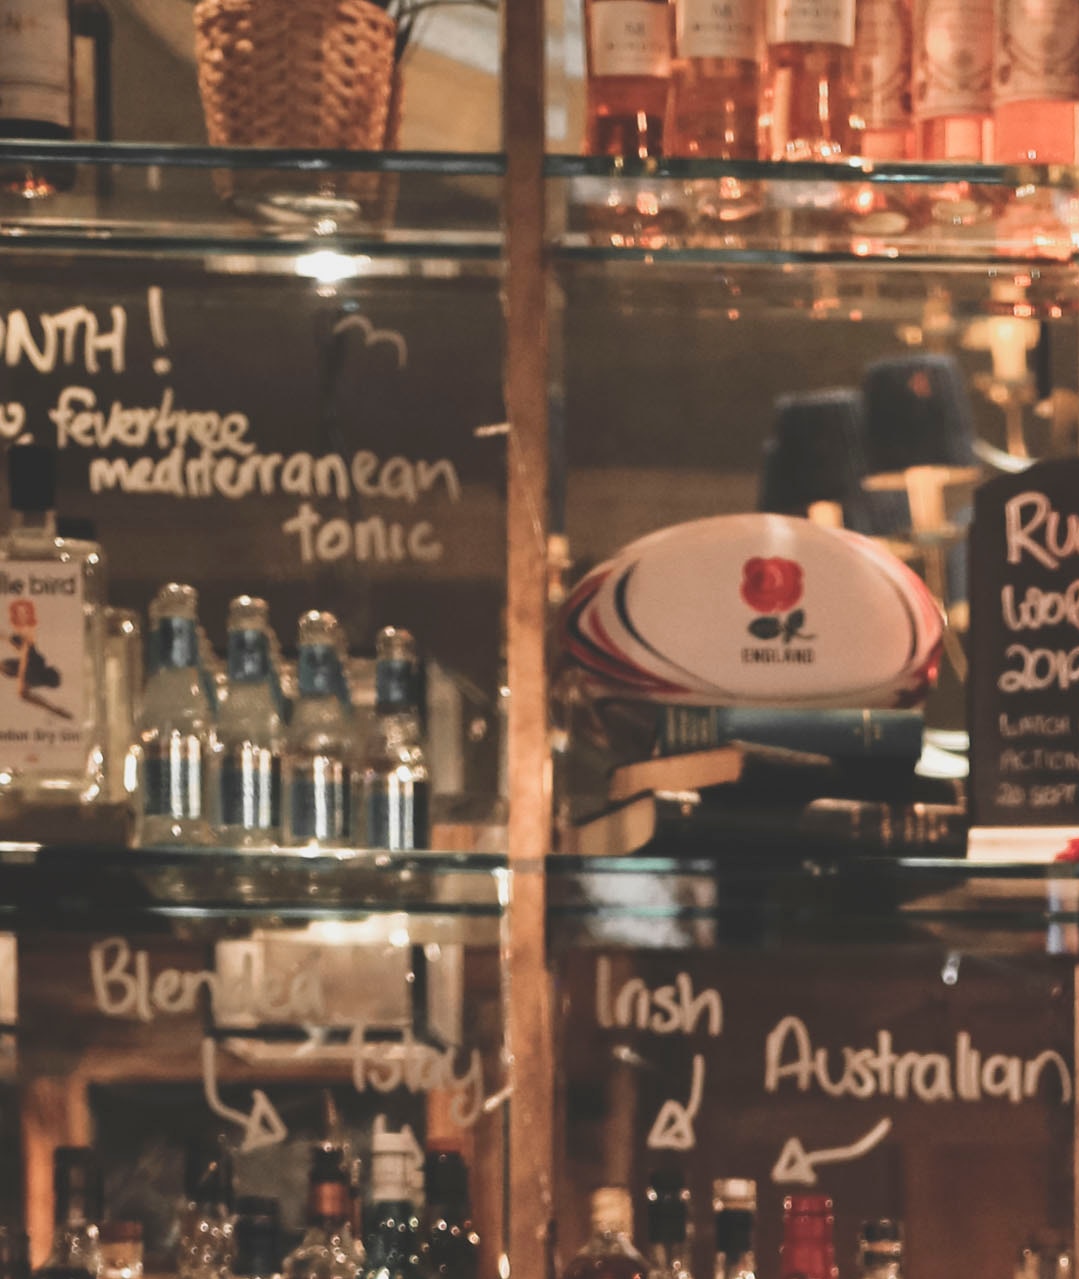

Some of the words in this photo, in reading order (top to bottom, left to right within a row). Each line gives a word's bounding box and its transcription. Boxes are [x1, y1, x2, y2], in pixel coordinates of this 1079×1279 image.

[0, 304, 127, 374] NTH
[49, 385, 255, 456] fevertree
[89, 449, 462, 502] mediterranean
[282, 501, 444, 563] tonic
[29, 576, 76, 595] bird
[740, 647, 816, 664] ENGLAND
[596, 956, 723, 1036] Irish
[764, 1016, 1073, 1104] Australian
